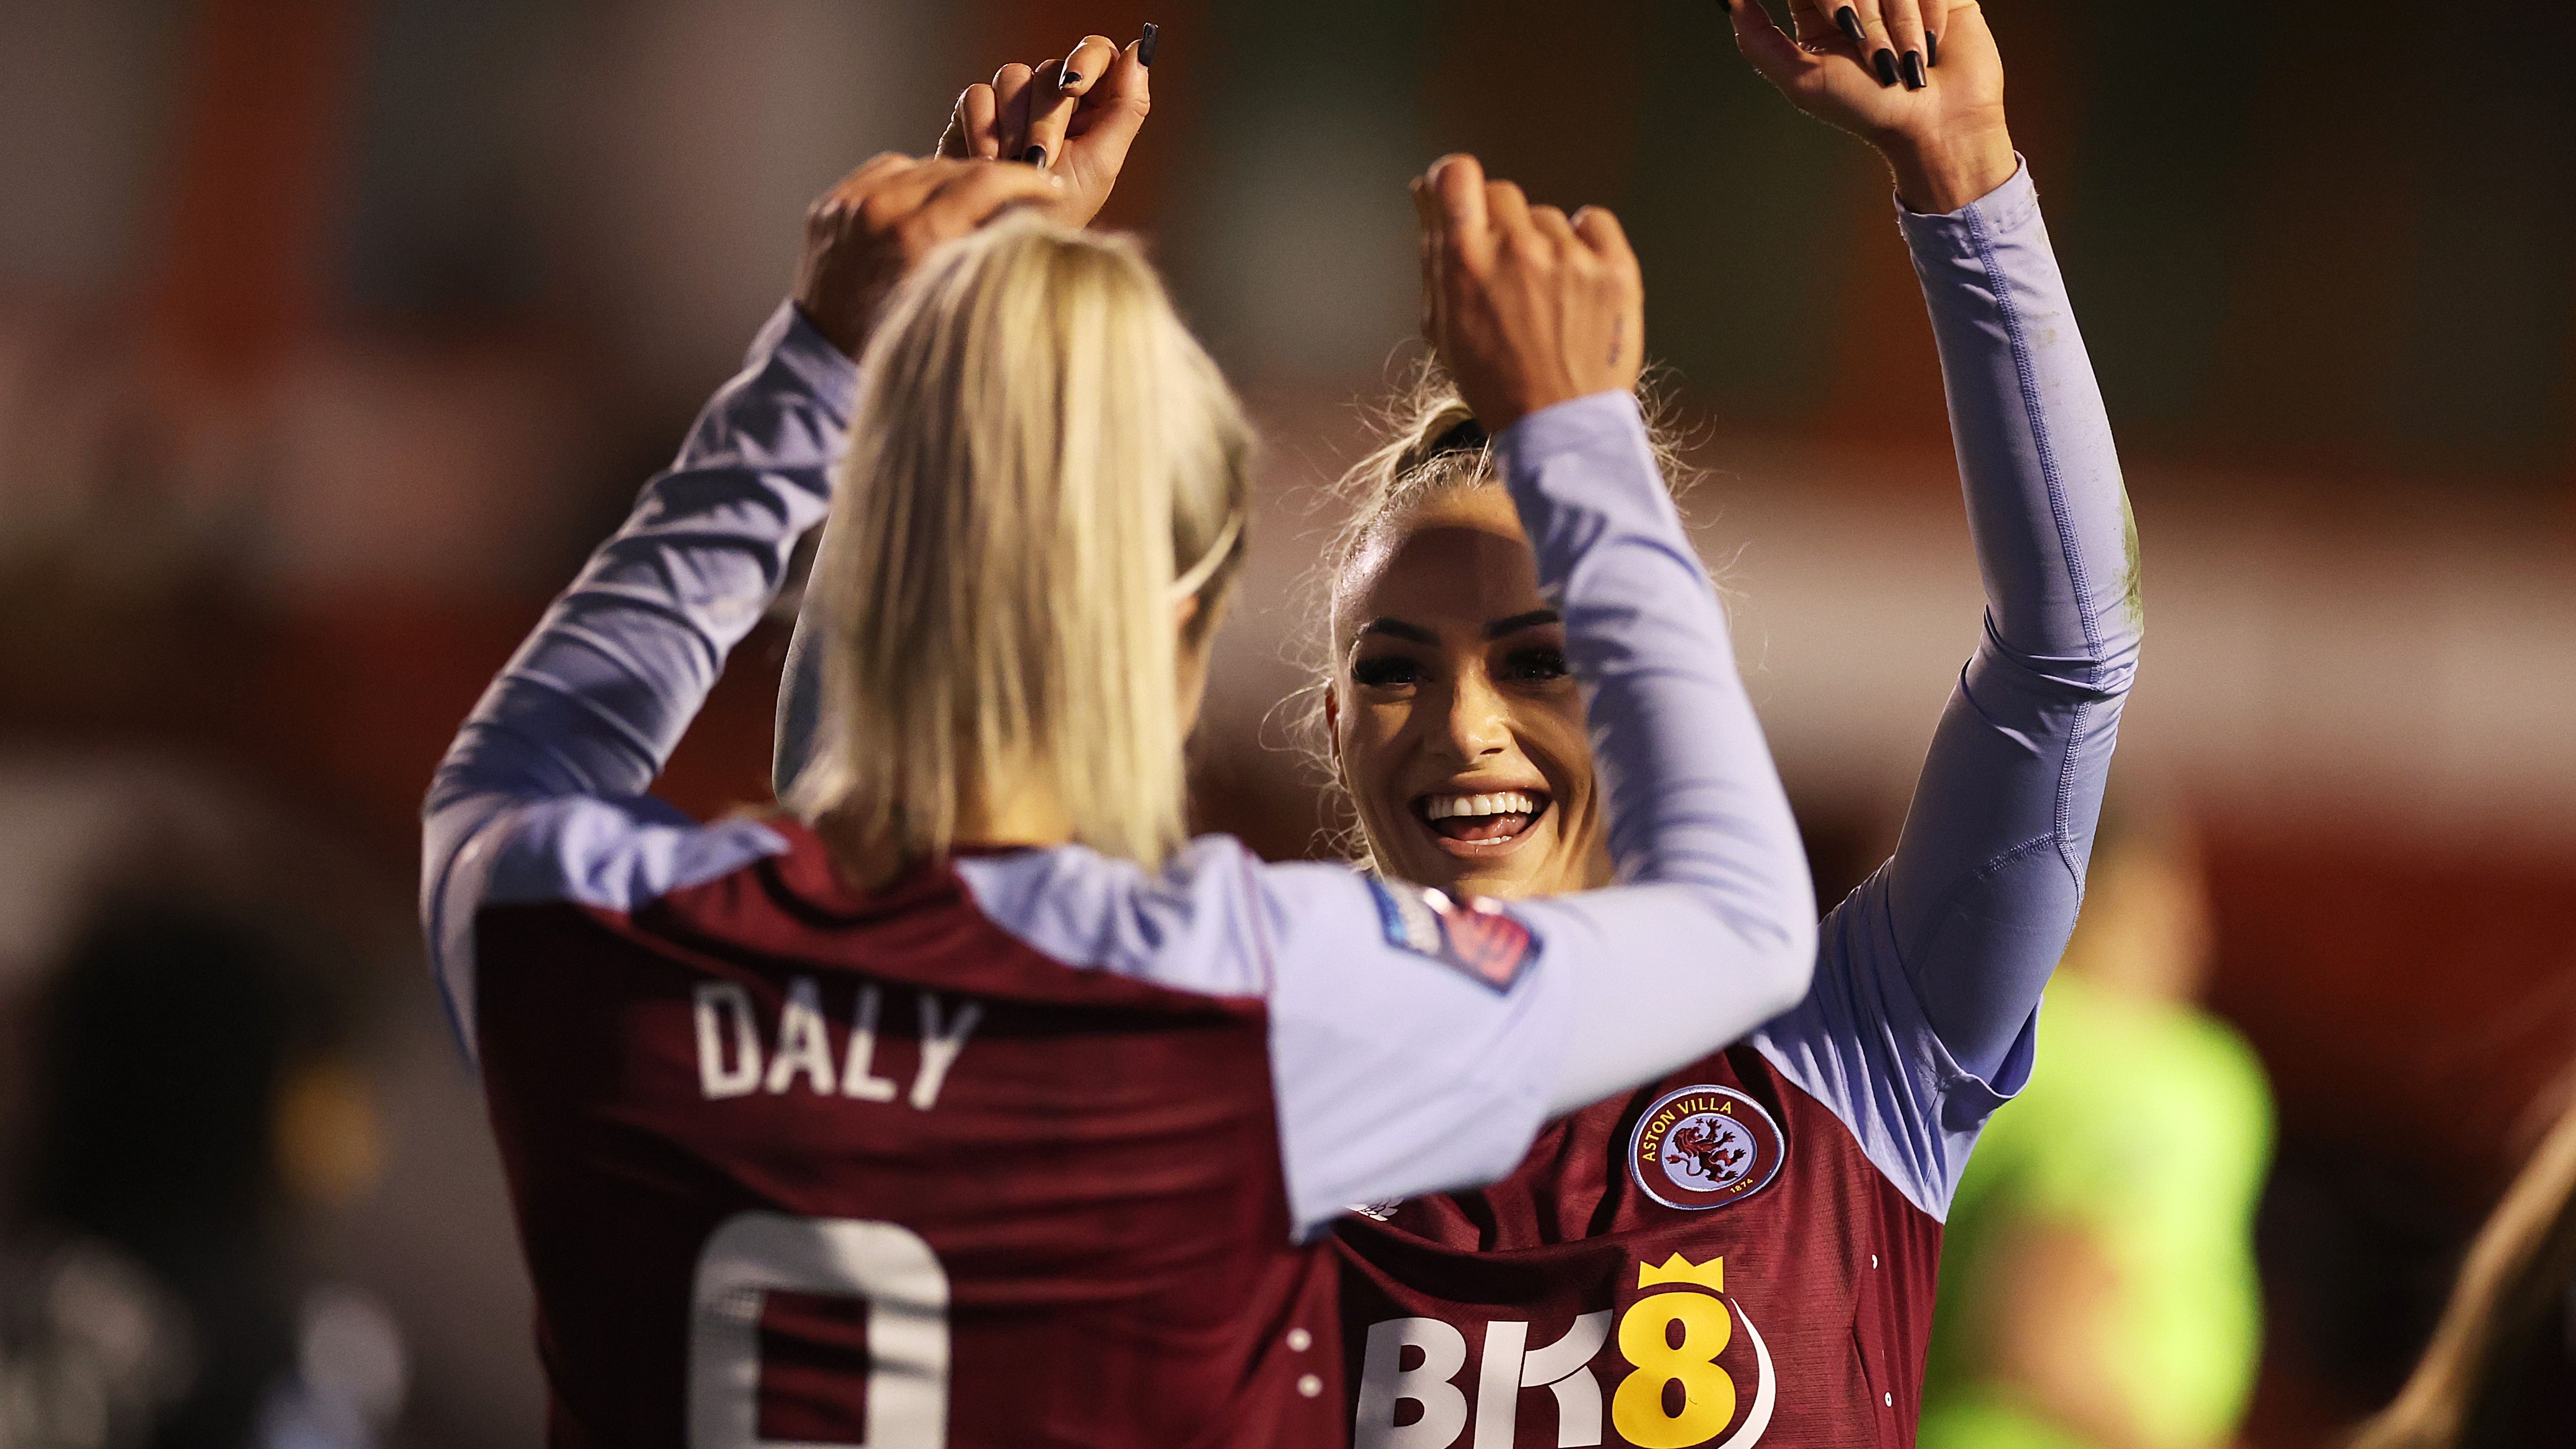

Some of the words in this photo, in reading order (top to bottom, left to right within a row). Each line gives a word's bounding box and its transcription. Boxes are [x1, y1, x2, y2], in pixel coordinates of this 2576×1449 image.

[694, 977, 983, 1110] DALY
[1643, 1110, 1676, 1162] ASTON
[1677, 1097, 1732, 1115] VILLA
[1730, 1178, 1753, 1193] 1874
[1354, 1292, 1737, 1449] BK8
